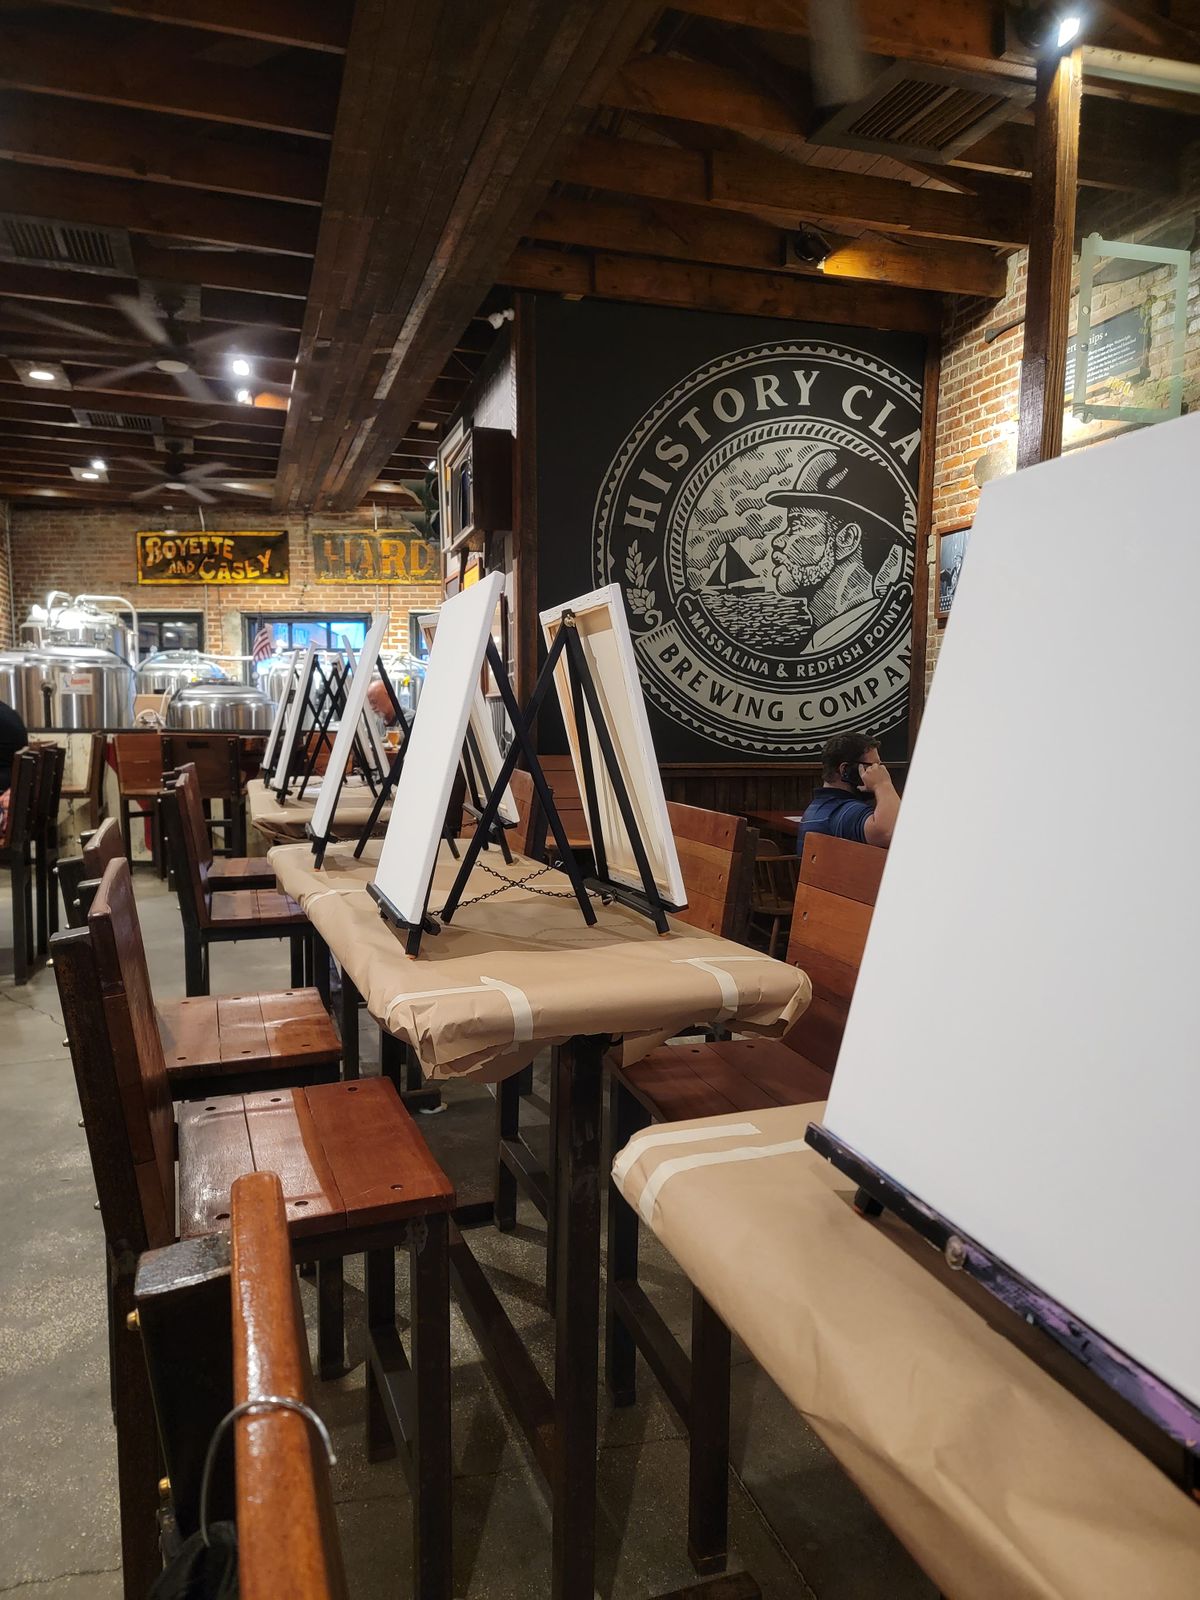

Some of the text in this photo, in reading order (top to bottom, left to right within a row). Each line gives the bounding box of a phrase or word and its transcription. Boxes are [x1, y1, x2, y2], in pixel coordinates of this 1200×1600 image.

[623, 370, 921, 532] HISTORY CLA
[168, 560, 195, 574] AND
[323, 539, 435, 578] HARD
[688, 601, 902, 678] MASSALINA & REDFISH POINT
[659, 642, 784, 721] BREWING
